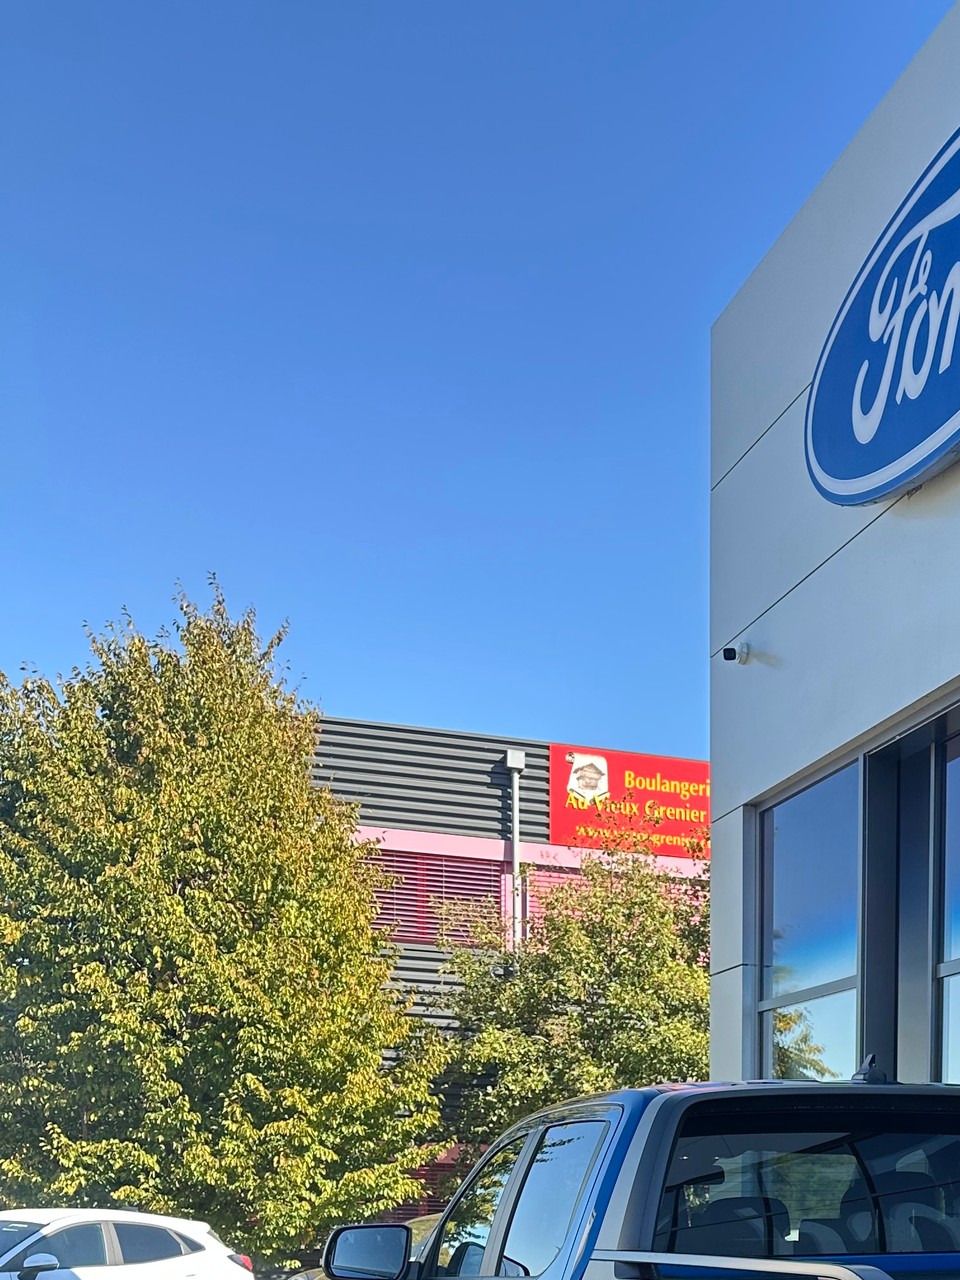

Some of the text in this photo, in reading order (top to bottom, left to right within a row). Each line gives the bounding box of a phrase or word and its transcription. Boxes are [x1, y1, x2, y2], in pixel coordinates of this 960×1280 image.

[565, 791, 707, 822] Au Vieux Grenier
